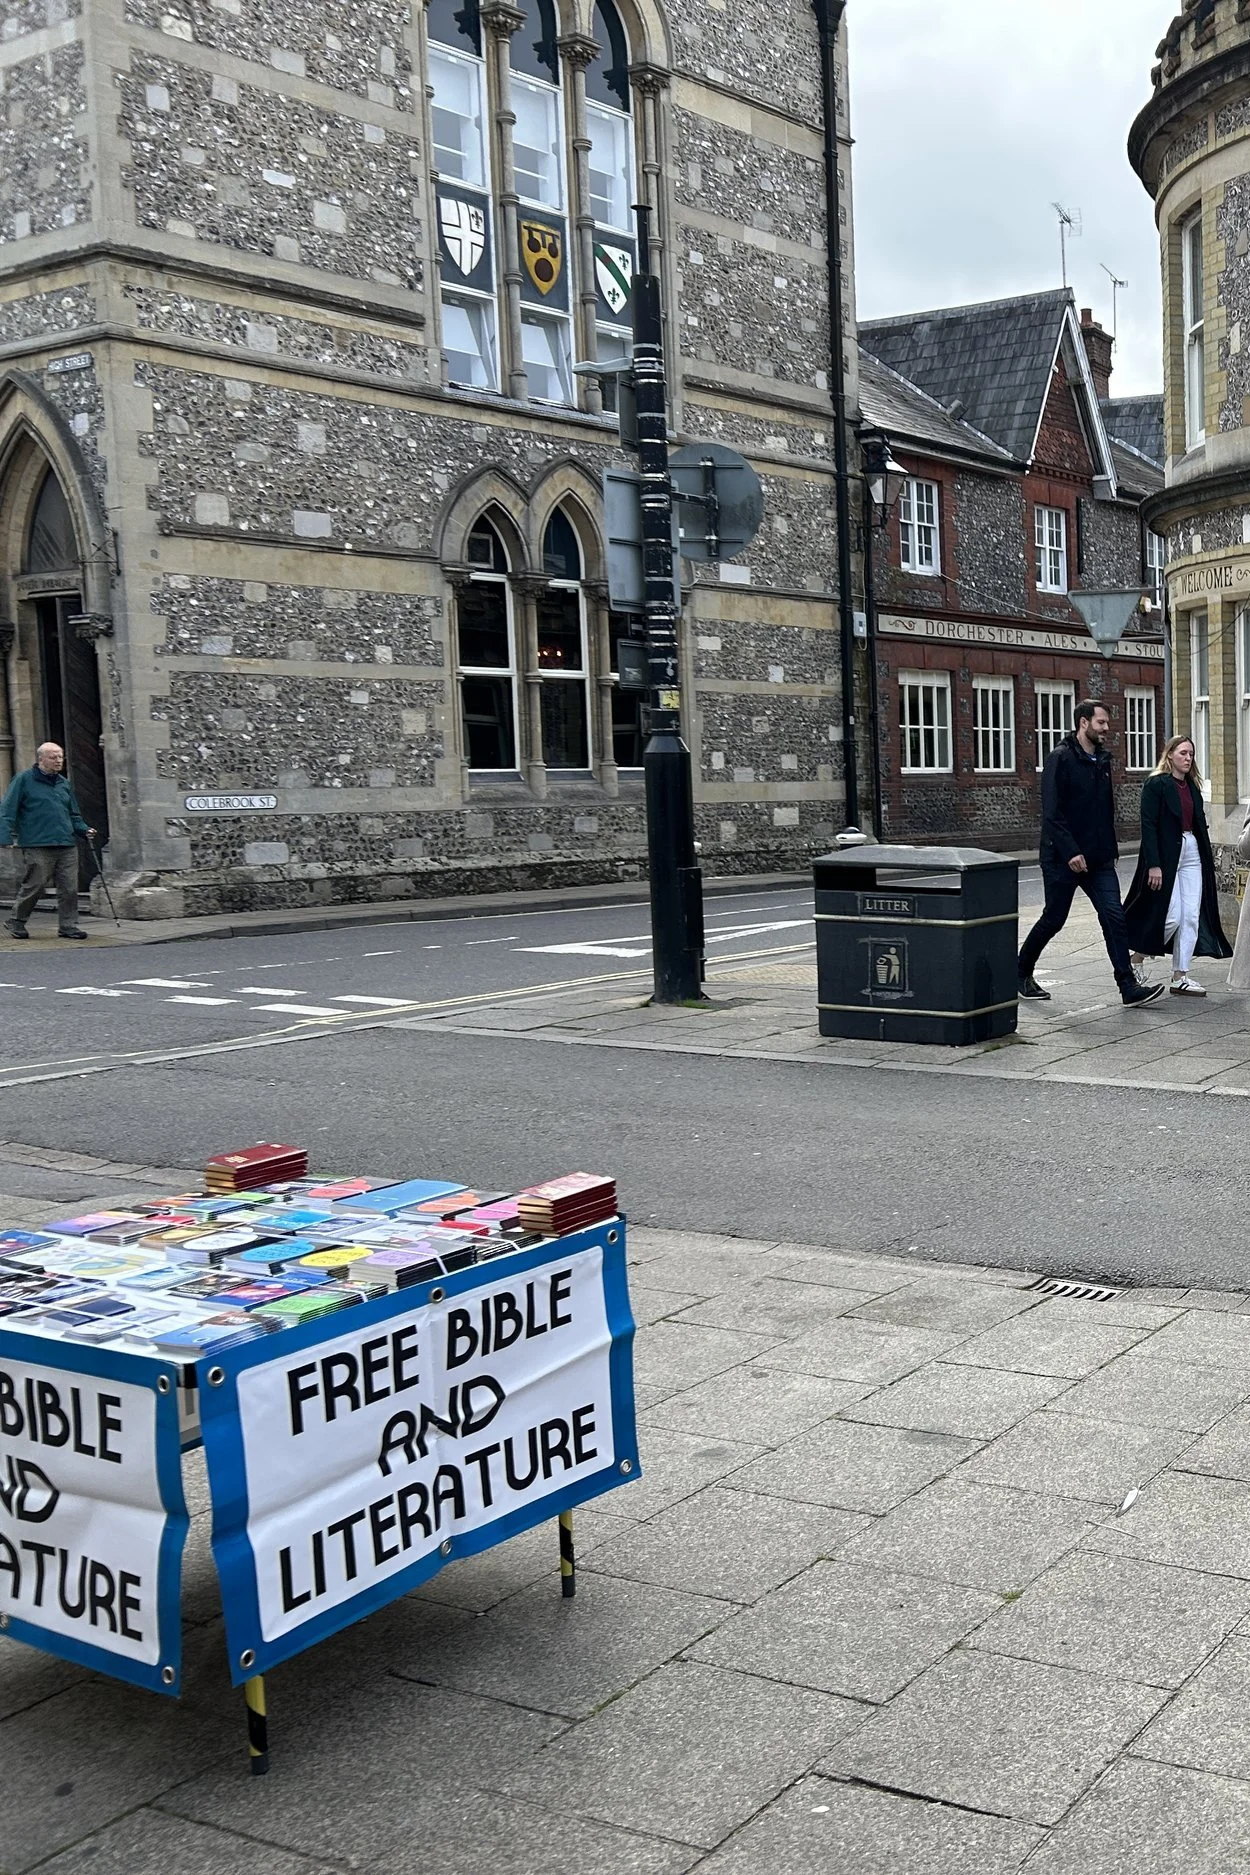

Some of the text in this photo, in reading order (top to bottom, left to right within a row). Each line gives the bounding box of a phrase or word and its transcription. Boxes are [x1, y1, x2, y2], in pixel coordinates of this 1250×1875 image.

[1181, 566, 1233, 595] WELCOME
[925, 620, 1024, 644] DORCHESTER
[1044, 634, 1078, 650] ALES
[190, 796, 274, 808] COLEBROOK ST.
[864, 899, 910, 912] LITTER
[286, 1268, 574, 1436] FREE BIBLE
[0, 1371, 122, 1464] BIBLE
[378, 1375, 506, 1477] AND
[279, 1403, 598, 1614] LITERATURE
